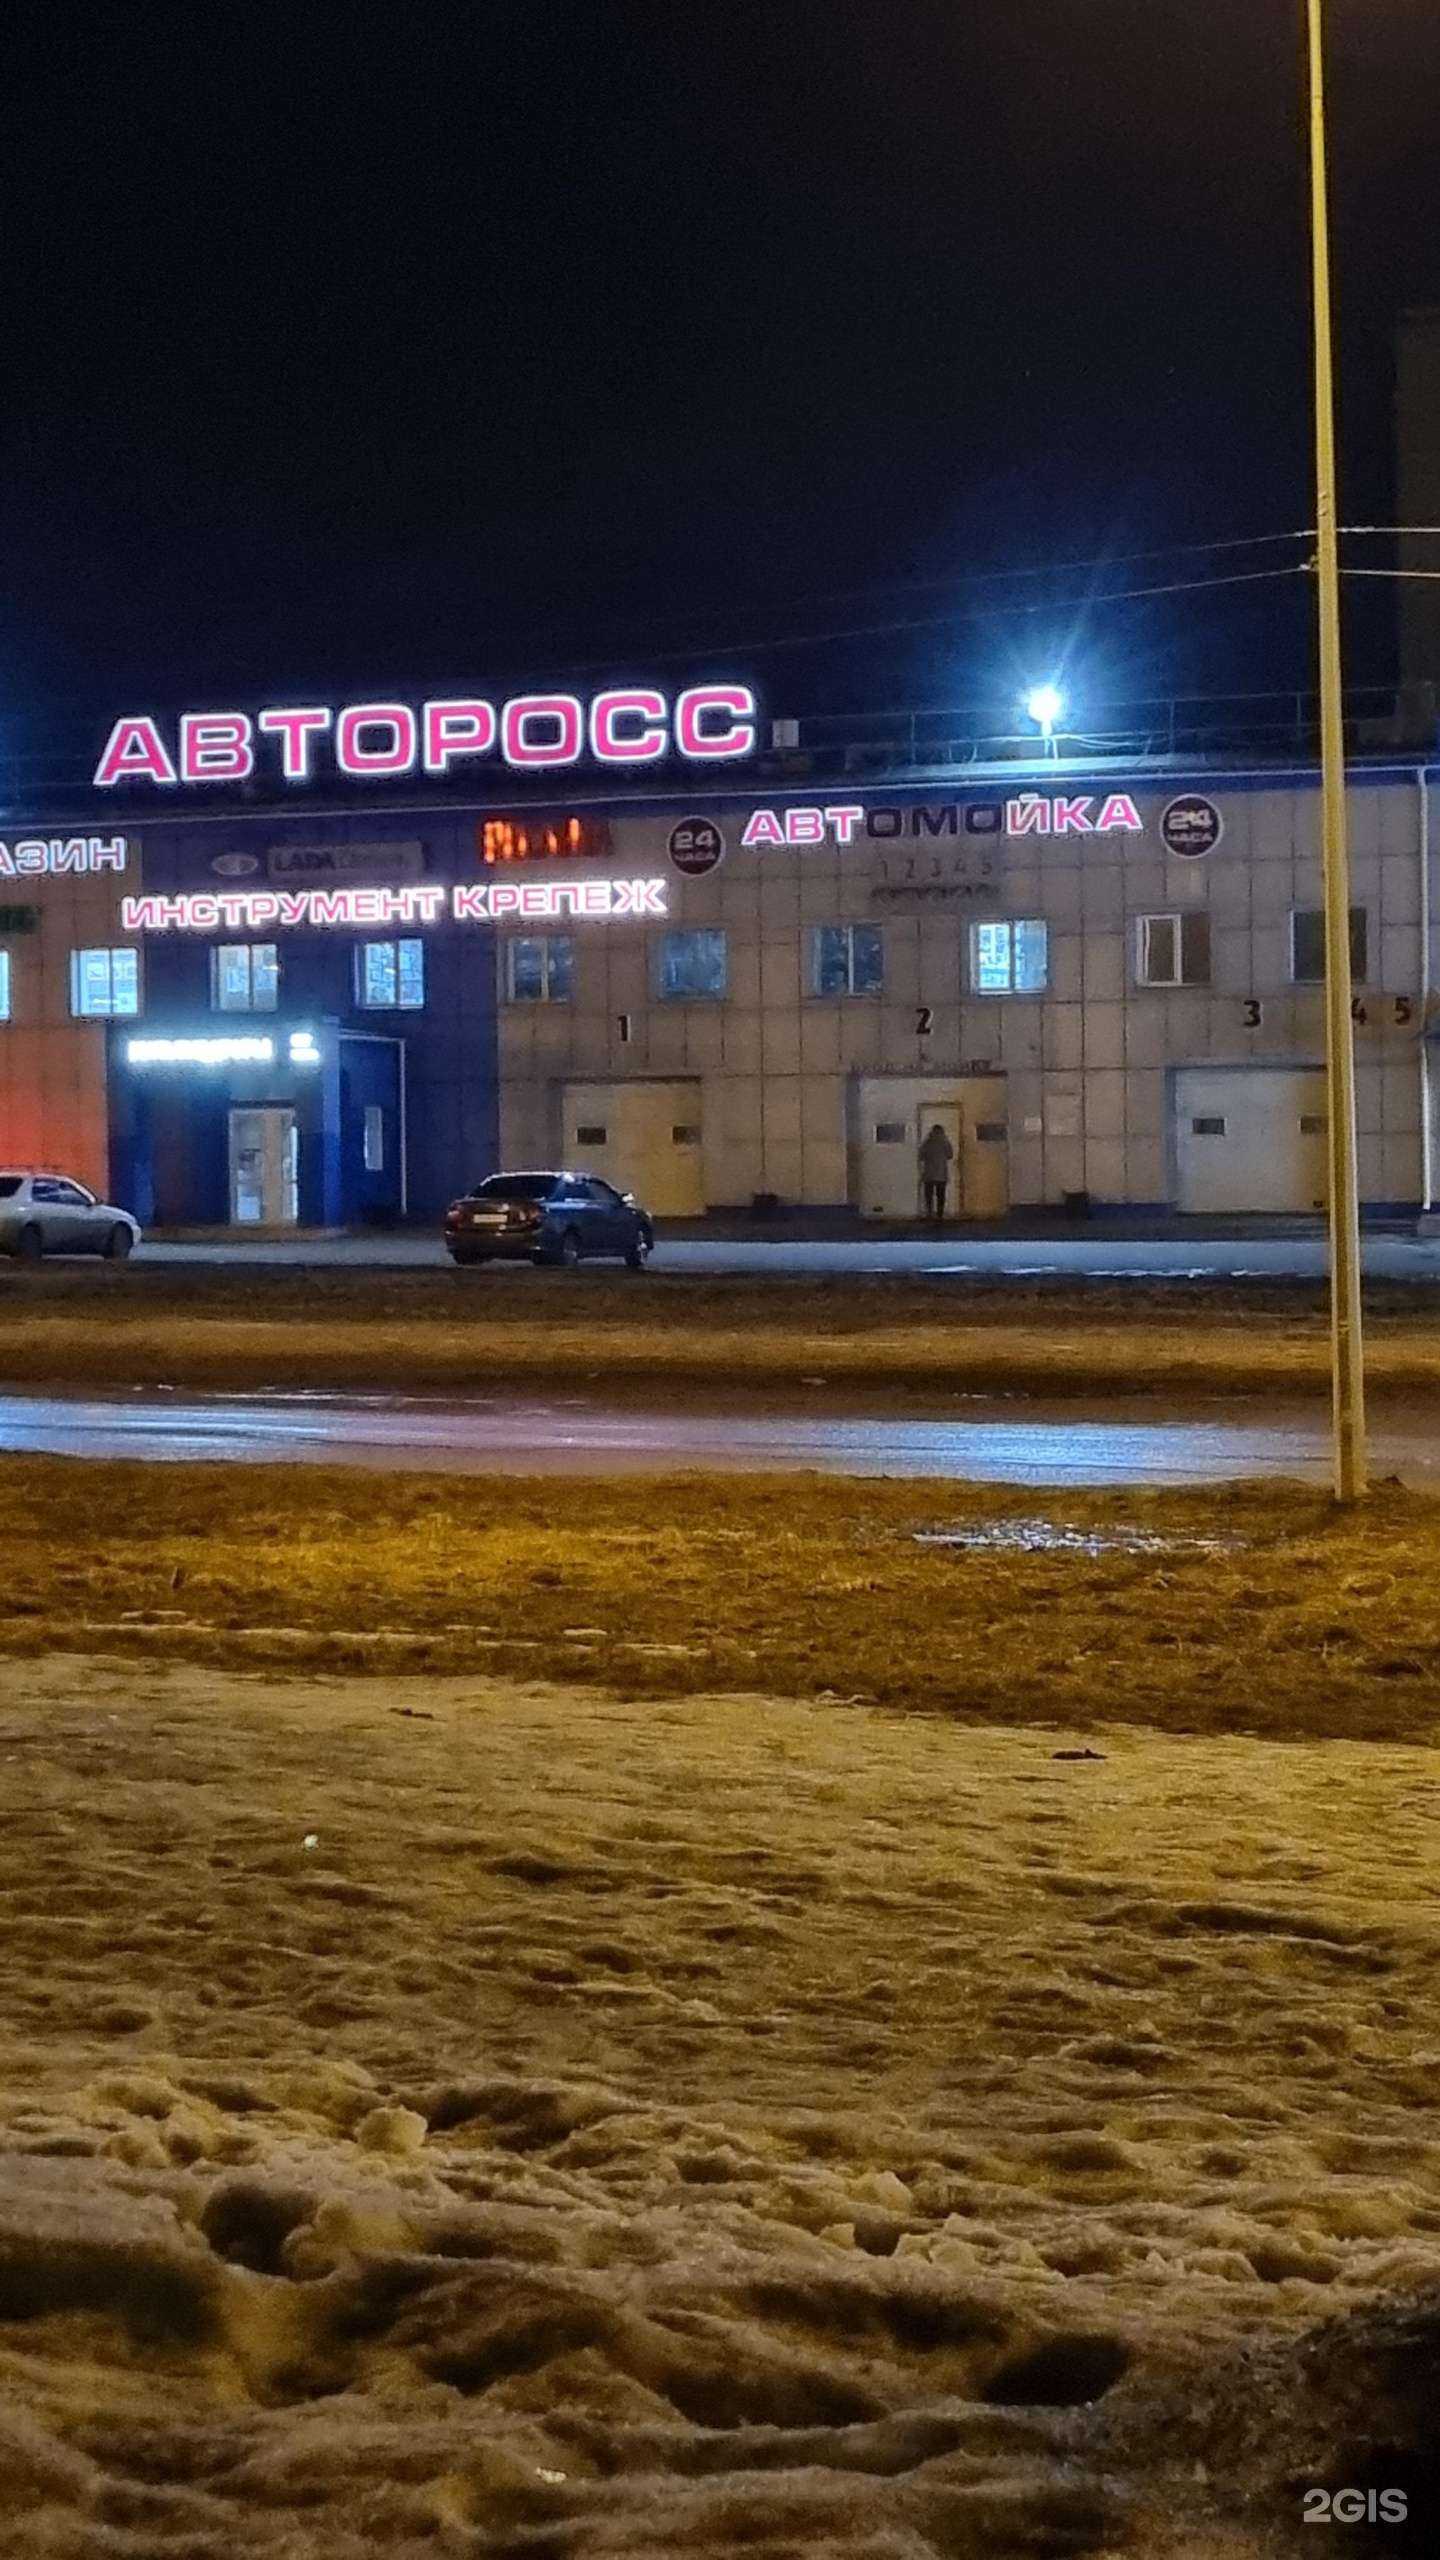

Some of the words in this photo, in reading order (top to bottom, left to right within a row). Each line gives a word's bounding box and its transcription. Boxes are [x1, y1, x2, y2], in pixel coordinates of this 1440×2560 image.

[92, 685, 757, 788] АВТОРОСС
[741, 793, 1144, 846] АВТОМОЙКА
[1168, 809, 1213, 830] 24
[675, 829, 715, 849] 24
[121, 886, 444, 930] ИНСТРУМЕНТ
[453, 878, 669, 920] КРЕПЕЖ
[915, 1007, 932, 1035] 2
[1243, 999, 1262, 1028] 3
[1351, 997, 1368, 1026] 4
[1395, 996, 1412, 1026] 5
[617, 1015, 629, 1042] 1
